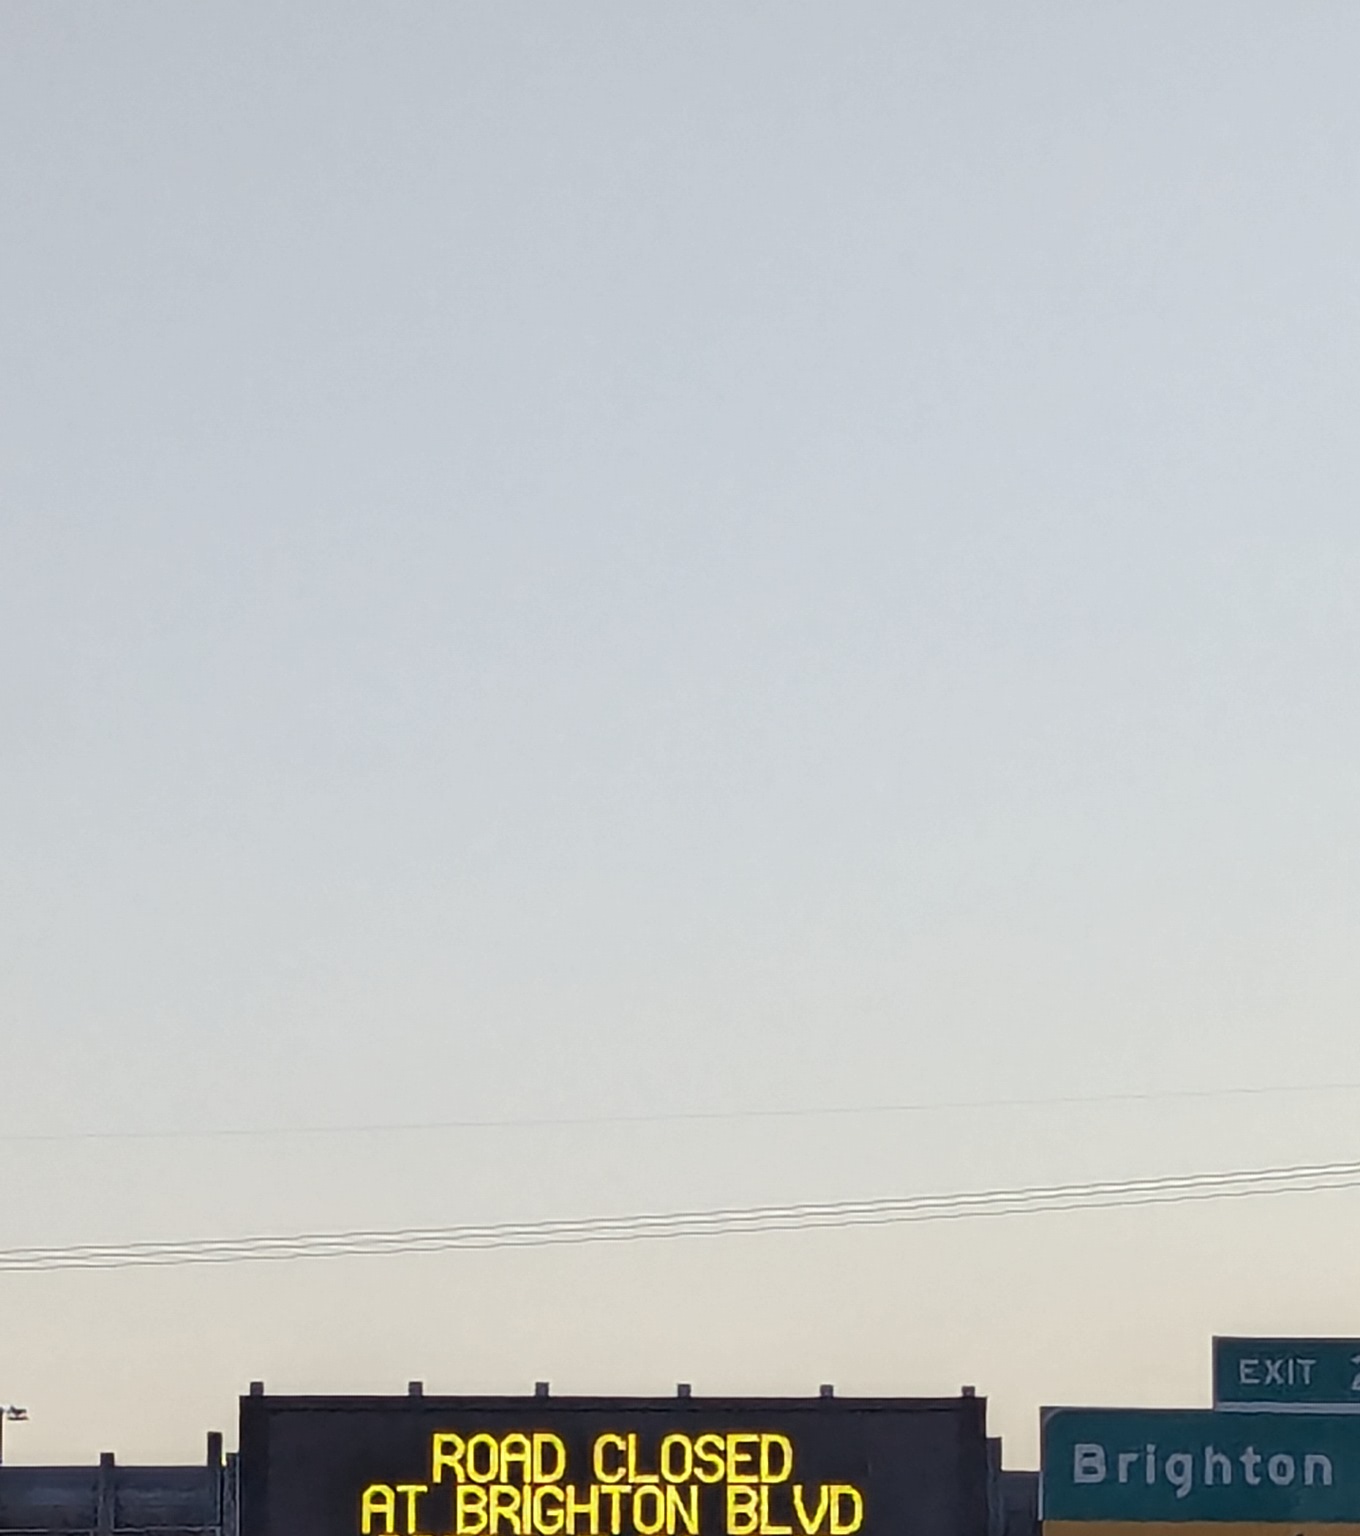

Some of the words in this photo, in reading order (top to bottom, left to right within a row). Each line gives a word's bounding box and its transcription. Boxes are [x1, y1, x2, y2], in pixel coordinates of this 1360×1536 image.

[1239, 1357, 1317, 1386] EXIT
[432, 1433, 566, 1485] ROAD
[593, 1433, 793, 1486] CLOSED
[1072, 1442, 1334, 1498] Brighton
[361, 1485, 428, 1536] AT
[456, 1485, 700, 1536] BRIGHTON
[726, 1485, 864, 1536] BLVD
